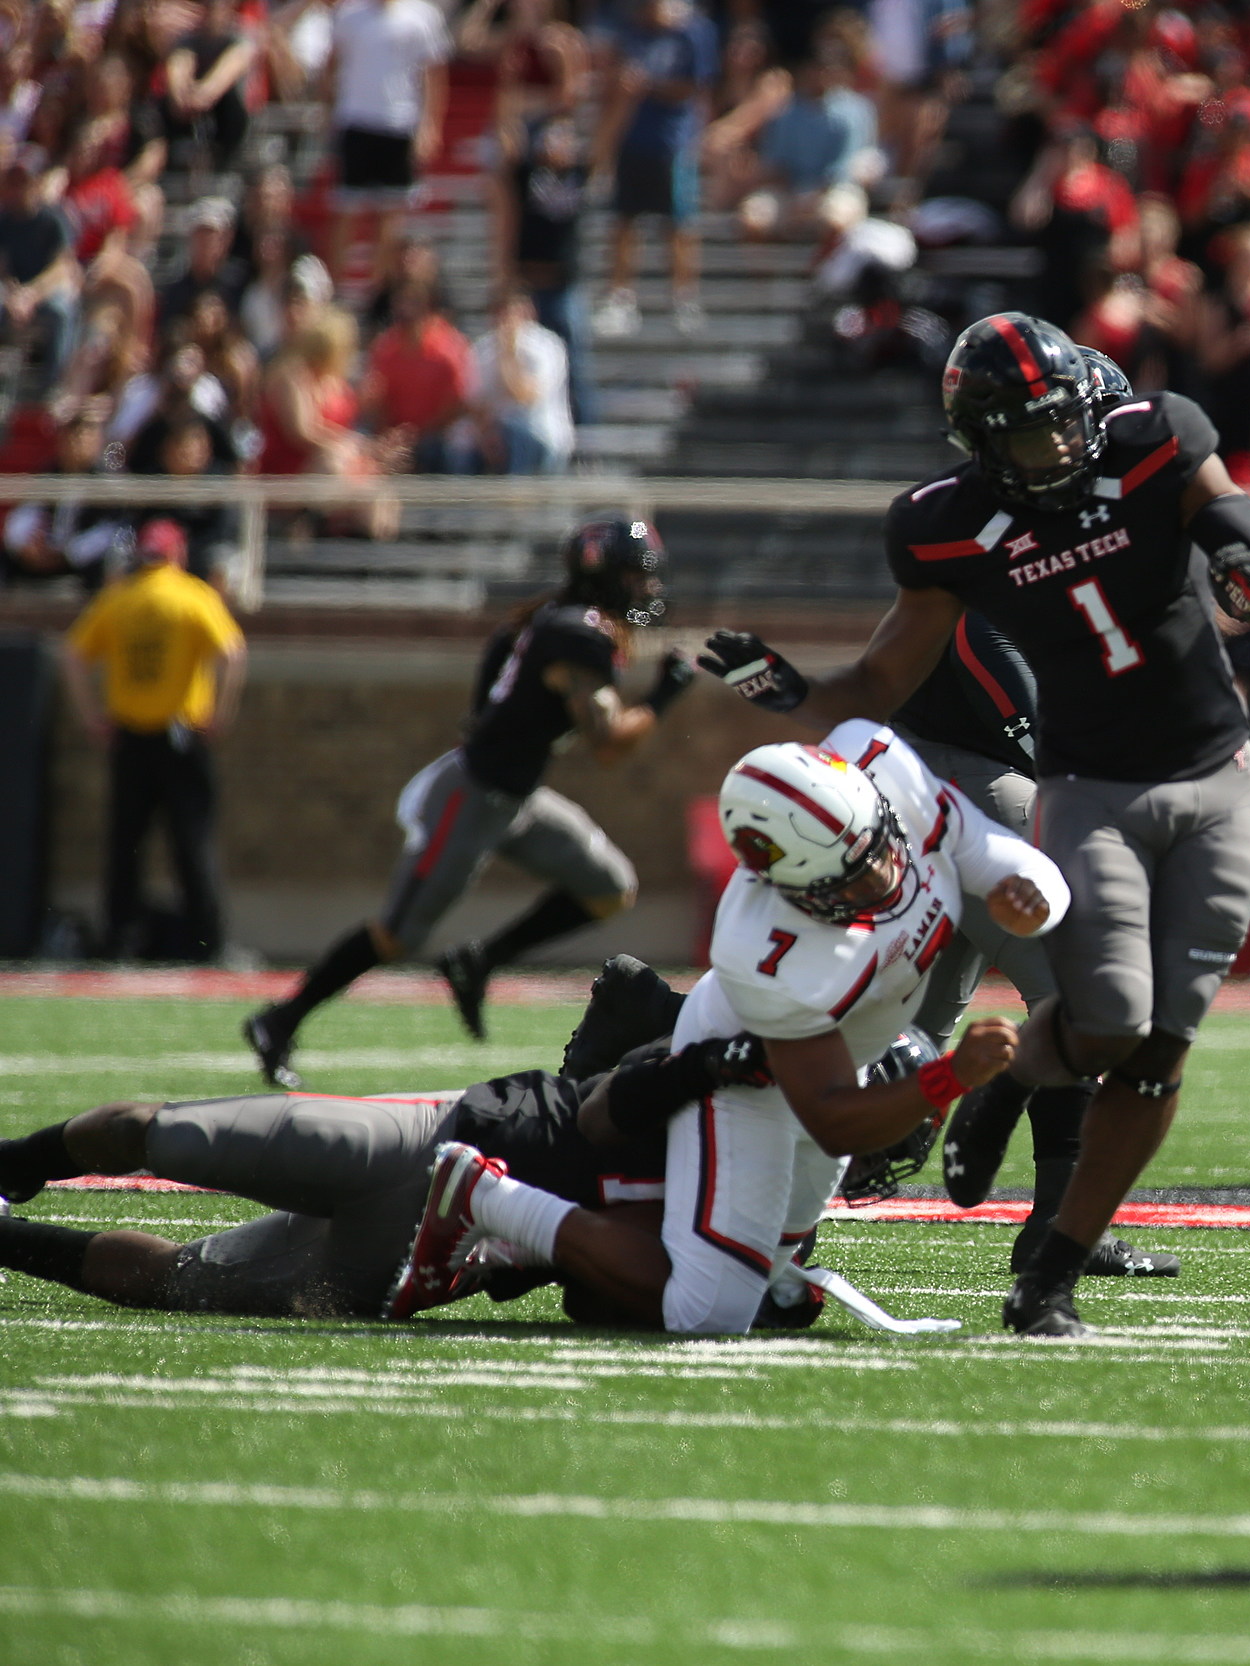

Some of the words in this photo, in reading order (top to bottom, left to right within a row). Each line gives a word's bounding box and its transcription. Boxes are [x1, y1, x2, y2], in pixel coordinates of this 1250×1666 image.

[1007, 549, 1076, 587] TEXAS
[1074, 527, 1131, 562] TECH
[1066, 575, 1147, 679] 1
[755, 926, 799, 977] 7
[903, 897, 943, 961] LAMAR
